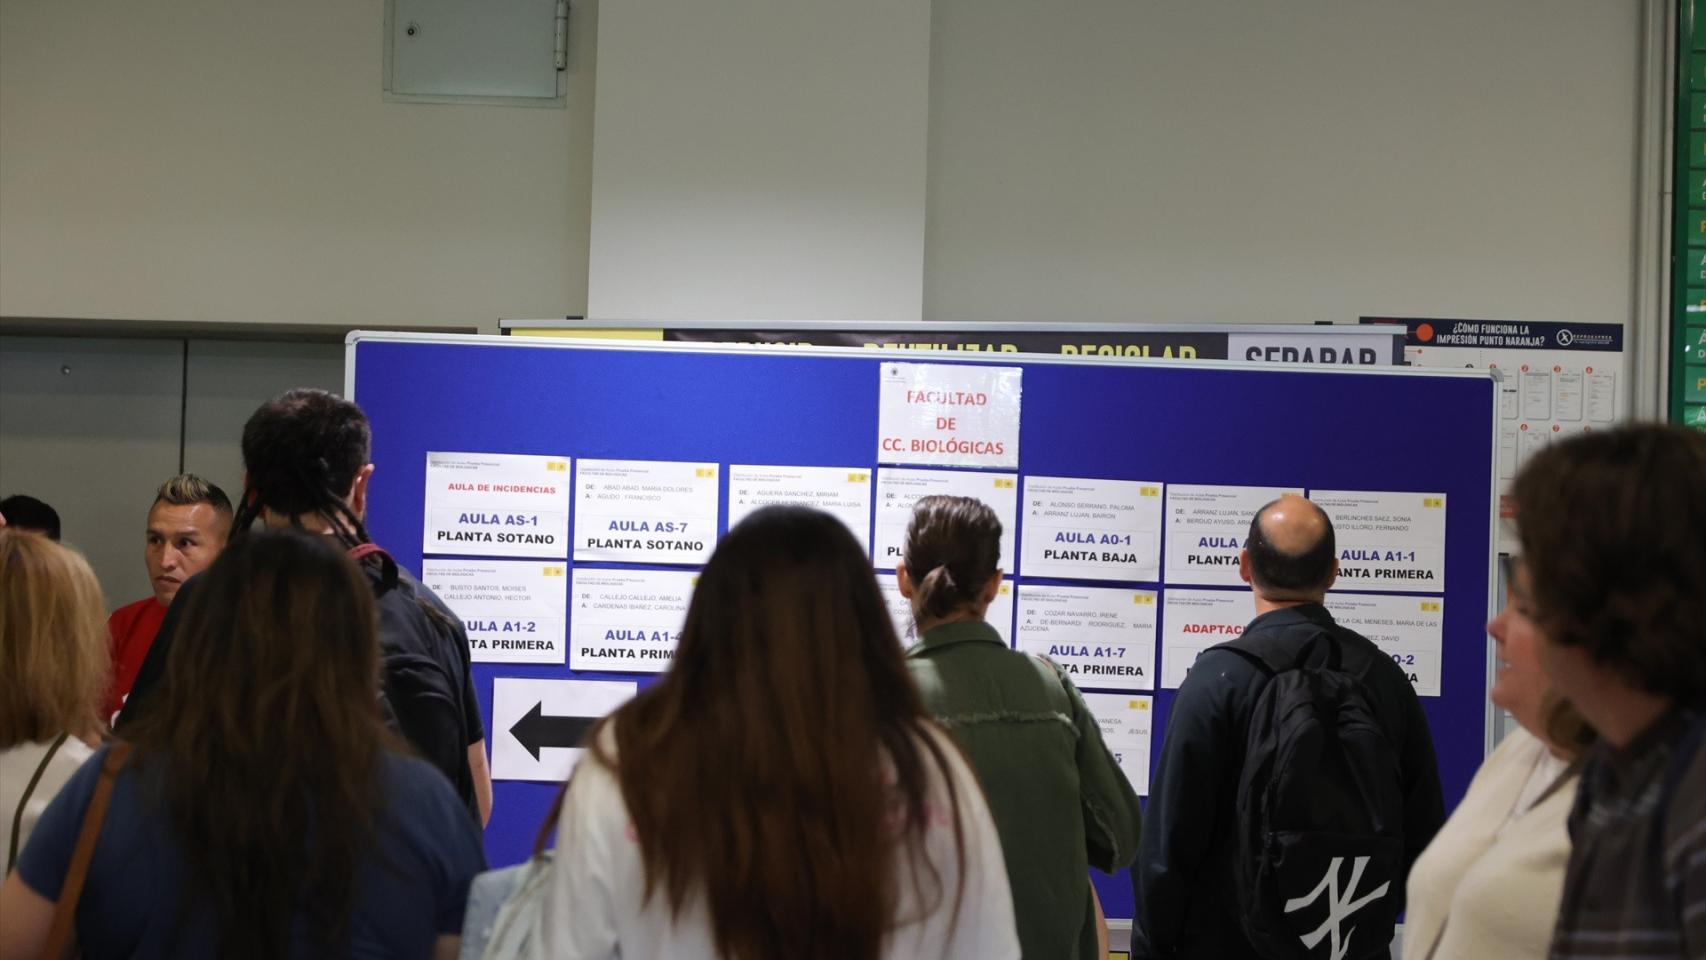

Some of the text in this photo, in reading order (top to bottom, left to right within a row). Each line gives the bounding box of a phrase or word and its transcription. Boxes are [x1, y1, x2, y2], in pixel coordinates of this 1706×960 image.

[1453, 322, 1529, 335] ¿CÓMO FUNCIONA LA
[1436, 334, 1545, 346] IMPRESIÓN PUNTO NARANJA?
[907, 390, 988, 406] FACULTAD
[936, 417, 956, 430] DE
[882, 436, 1004, 455] CC. BIOLÓGICAS
[448, 483, 556, 494] AULA DE INCIDENCIAS
[459, 513, 538, 526] AULA AS-1
[609, 520, 688, 533] AULA AS-7
[438, 531, 554, 544] PLANTA SOTANO
[1055, 532, 1131, 545] AULA A0-1
[1199, 537, 1238, 548] AULA
[588, 538, 703, 551] PLANTA SOTANO
[1044, 550, 1137, 563] PLANTA BAJA
[1188, 555, 1240, 565] PLANTA
[1341, 550, 1415, 562] AULA A1-1
[1336, 568, 1433, 580] ANTA PRIMERA
[503, 621, 536, 632] A1-2
[605, 630, 646, 641] AULA
[492, 640, 554, 650] PRIMERA
[582, 647, 674, 659] PLANTA PRIM
[1049, 645, 1126, 658] AULA A1-7
[1083, 665, 1143, 676] PRIMERA
